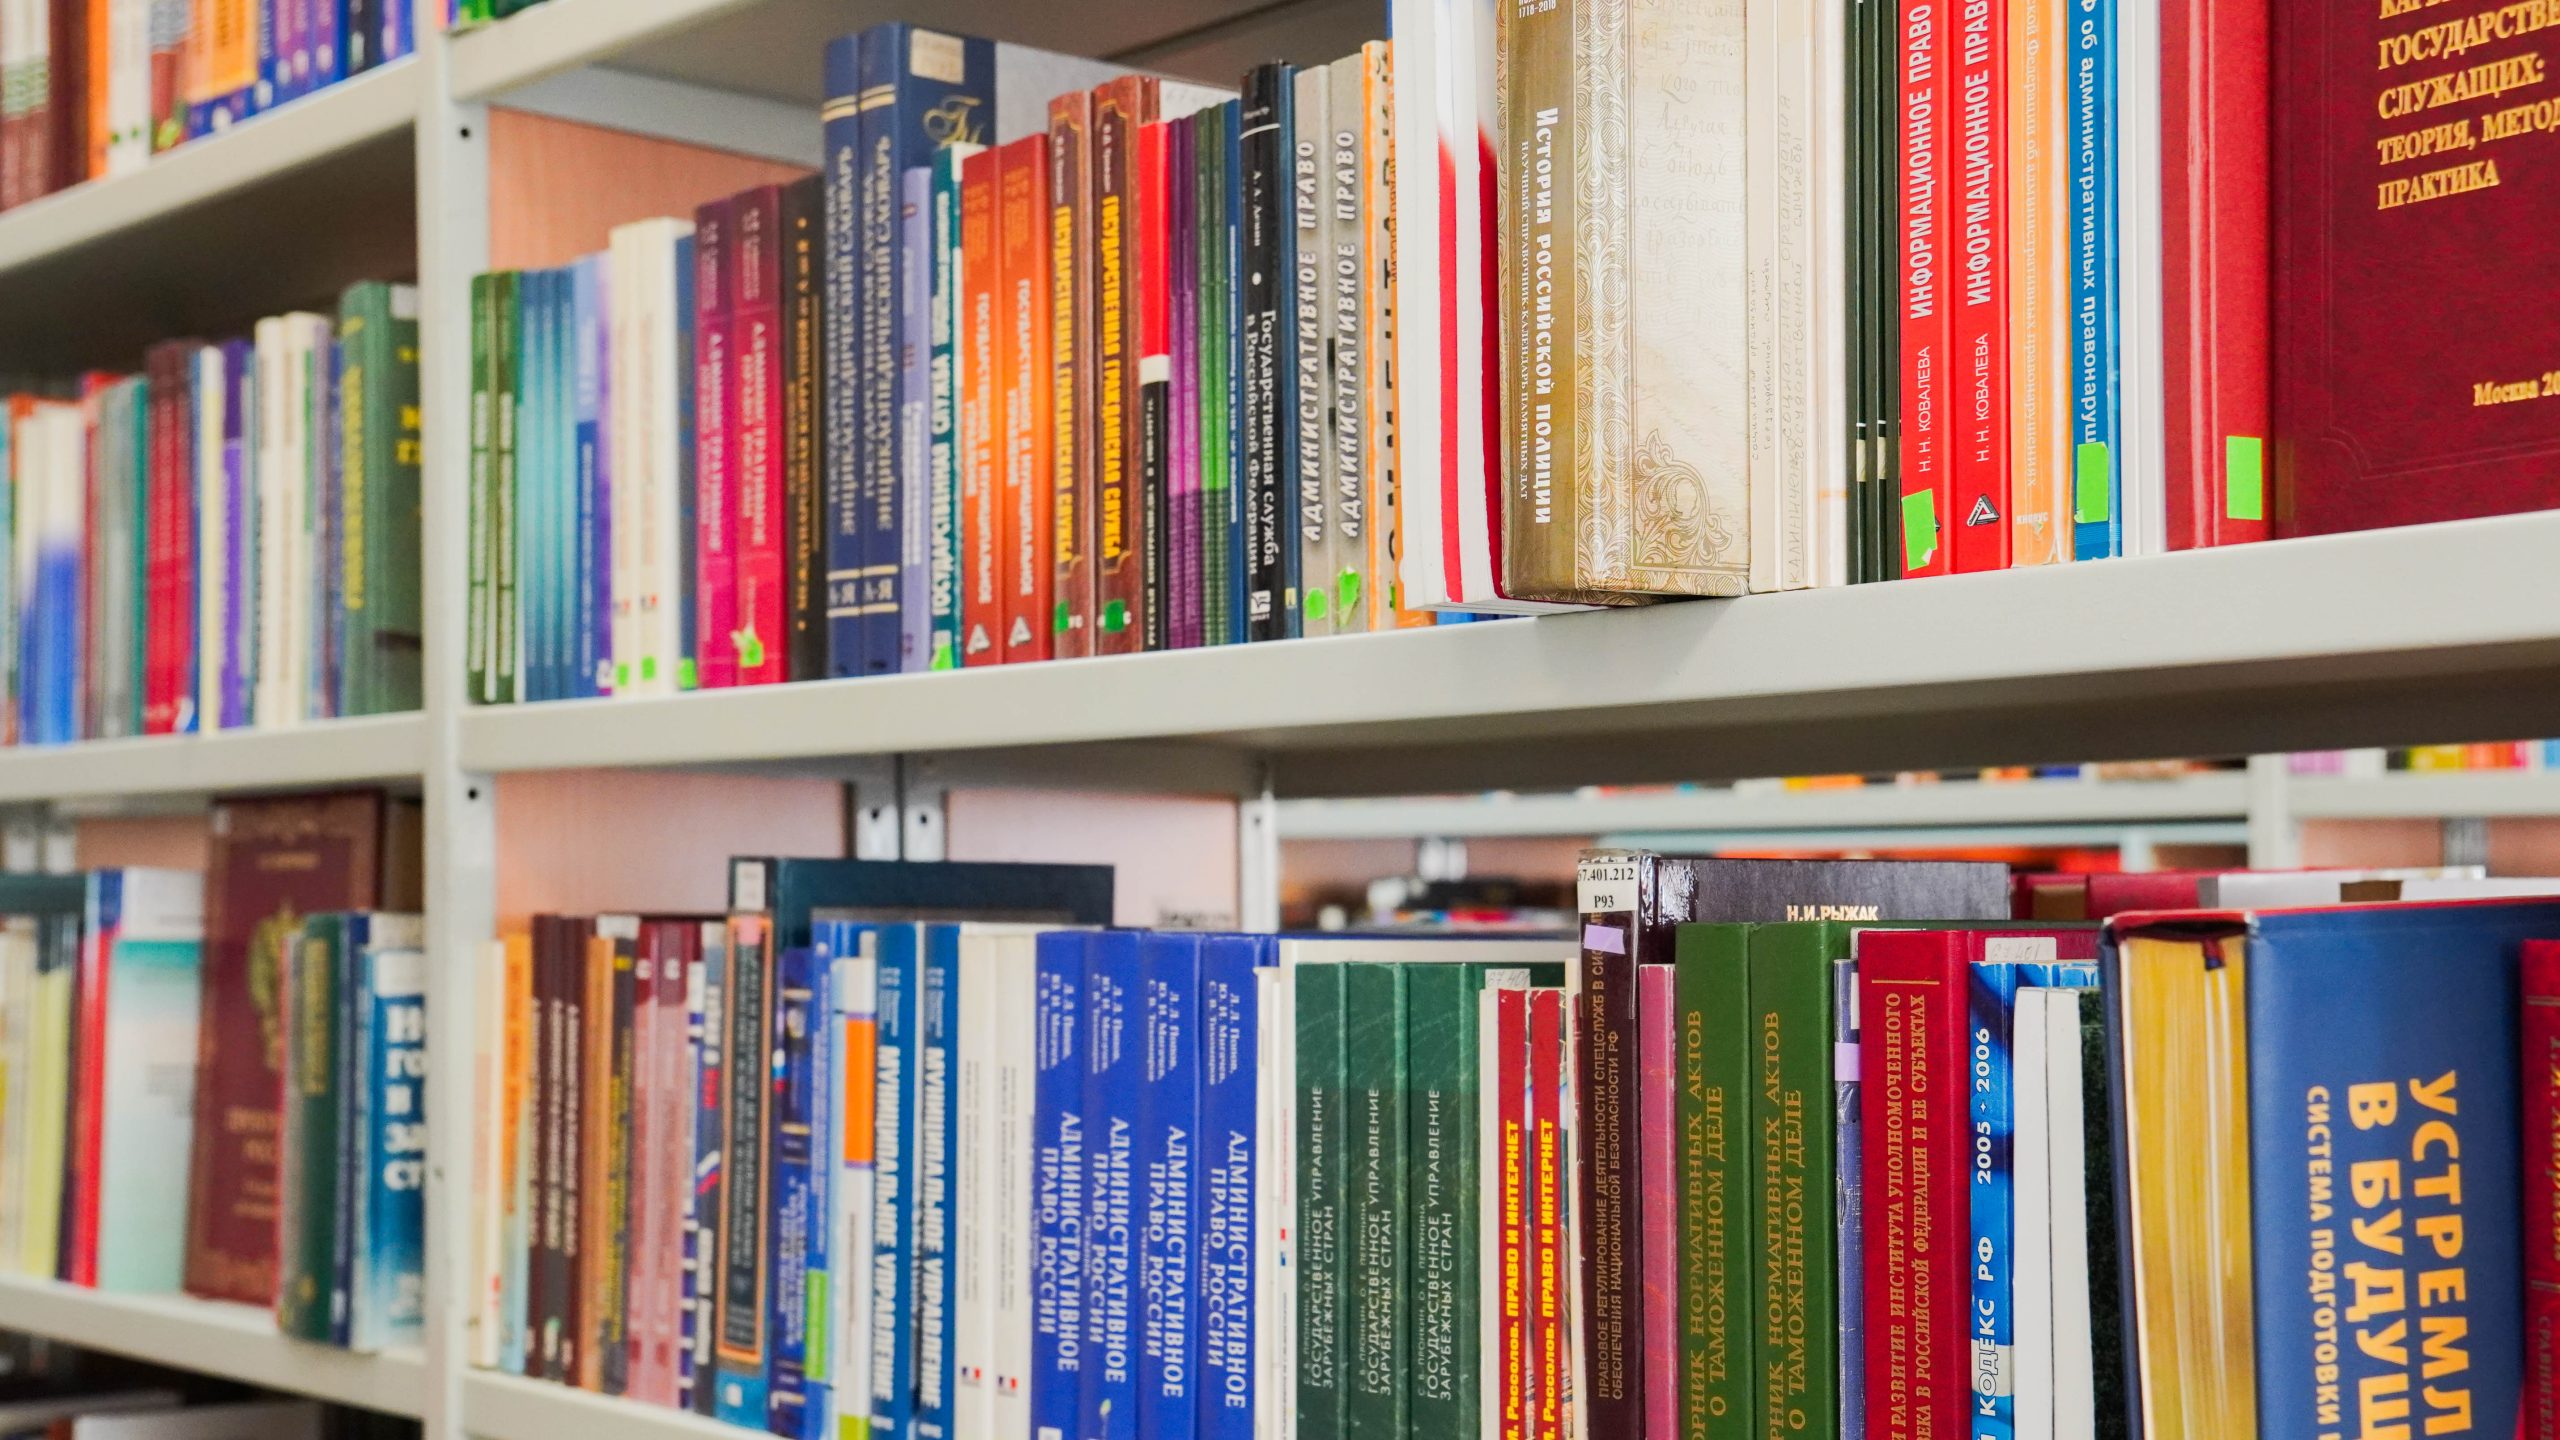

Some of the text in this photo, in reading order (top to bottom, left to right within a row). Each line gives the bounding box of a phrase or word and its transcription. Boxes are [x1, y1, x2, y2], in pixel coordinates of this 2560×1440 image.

[2081, 20, 2097, 49] об
[2378, 52, 2545, 119] СЛУЖАЩИХ:
[1521, 141, 1531, 211] НАУЧНЫЙ
[1909, 5, 1935, 319] ИНФОРМАЦИОННОЕ ПРАВО
[1965, 70, 1993, 306] ИНФОРМАЦИОННОЕ
[2079, 58, 2096, 289] административных
[2377, 119, 2476, 166] ТЕОРИЯ,
[2377, 159, 2499, 209] ПРАКТИКА
[1102, 195, 1120, 355] ГОСУДАРСТВЕННАЯ
[1297, 140, 1322, 542] АДМИНИСТРАТИВНОЕ ПРАВО
[1336, 131, 1361, 538] АДМИНИСТРАТИВНОЕ ПРАВО
[1533, 107, 1558, 524] История российской полиции
[1102, 359, 1121, 483] ГРАЖДАНСКАЯ
[1247, 332, 1260, 454] Российской
[1259, 310, 1279, 566] Государственная служба
[1520, 392, 1528, 471] ПАМЯТНЫХ
[1918, 346, 1931, 472] Н. Н. КОВАЛЕВА
[1976, 333, 1989, 462] Н. Н. КОВАЛЕВА
[2473, 380, 2539, 406] Москва
[1102, 487, 1121, 559] СЛУЖБА
[1248, 458, 1260, 575] Федерации
[1519, 473, 1528, 500] ДАТ
[1787, 905, 1879, 921] Н.И.РЫЖАК
[1687, 1011, 1702, 1100] АКТОВ
[1764, 1012, 1780, 1105] АКТОВ
[1910, 995, 1926, 1094] СУБЪЕКТАХ
[1912, 1100, 1926, 1120] ЕЕ
[1912, 1126, 1927, 1141] И
[1975, 1028, 1992, 1185] 2005 2006
[876, 1046, 900, 1247] МУНИЦИПАЛЬНОЕ
[923, 1047, 945, 1252] МУНИЦИПАЛЬНОЕ
[1311, 1087, 1323, 1387] ГОСУДАРСТВЕННОЕ УПРАВЛЕНИЕ
[1540, 1119, 1553, 1226] ИНТЕРНЕТ
[1541, 1229, 1553, 1245] И
[1593, 981, 1609, 1398] ПРАВОВОЕ РЕГУЛИРОВАНИЕ ДЕЯТЕЛЬНОСТИ СПЕЦСЛУЖБ В
[1607, 1031, 1623, 1401] ОБЕСПЕЧЕНИЯ НАЦИОНАЛЬНОЙ БЕЗОПАСНОСТИ РФ
[1687, 1112, 1704, 1337] НОРМАТИВНЫХ
[1765, 1117, 1783, 1348] НОРМАТИВНЫХ
[1886, 994, 1906, 1427] РАЗВИТИЕ ИНСТИТУТА УПОЛНОМОЧЕННОГО
[1913, 1147, 1931, 1253] ФЕДЕРАЦИИ
[872, 1252, 897, 1401] УПРАВЛЕНИЕ
[921, 1257, 943, 1408] УПРАВЛЕНИЕ
[1039, 1147, 1059, 1333] ПРАВО РОССИИ
[1058, 1111, 1081, 1371] АДМИНИСТРАТИВНОЕ
[1089, 1152, 1108, 1343] ПРАВО РОССИИ
[1104, 1116, 1130, 1383] АДМИНИСТРАТИВНОЕ
[1145, 1162, 1166, 1357] ПРАВО РОССИИ
[1162, 1125, 1187, 1398] АДМИНИСТРАТИВНОЕ
[1207, 1168, 1228, 1366] ПРАВО РОССИИ
[1224, 1130, 1248, 1408] АДМИНИСТРАТИВНОЕ
[1323, 1205, 1335, 1389] ЗАРУБЕЖНЫХ СТРАН
[1368, 1088, 1380, 1394] ГОСУДАРСТВЕННОЕ УПРАВЛЕНИЕ
[1380, 1210, 1392, 1396] ЗАРУБЕЖНЫХ СТРАН
[1427, 1090, 1440, 1399] ГОСУДАРСТВЕННОЕ УПРАВЛЕНИЕ
[1440, 1213, 1452, 1401] ЗАРУБЕЖНЫХ СТРАН
[1506, 1120, 1519, 1421] Рассолов. ПРАВО И ИНТЕРНЕТ
[1542, 1248, 1554, 1318] ПРАВО
[1706, 1087, 1726, 1417] О ТАМОЖЕННОМ ДЕЛЕ
[1784, 1090, 1806, 1430] О ТАМОЖЕННОМ ДЕЛЕ
[1911, 1259, 1931, 1381] РОССИЙСКОЙ
[1978, 1236, 1998, 1417] КОДЕКС РФ
[2307, 1084, 2342, 1424] СИСТЕМА ПОДГОТОВКИ
[2343, 1080, 2411, 1440] В БУДУЩ
[2408, 1069, 2472, 1435] УСТРЕМЛ
[1543, 1322, 1555, 1423] Рассолов.
[1916, 1386, 1931, 1399] В
